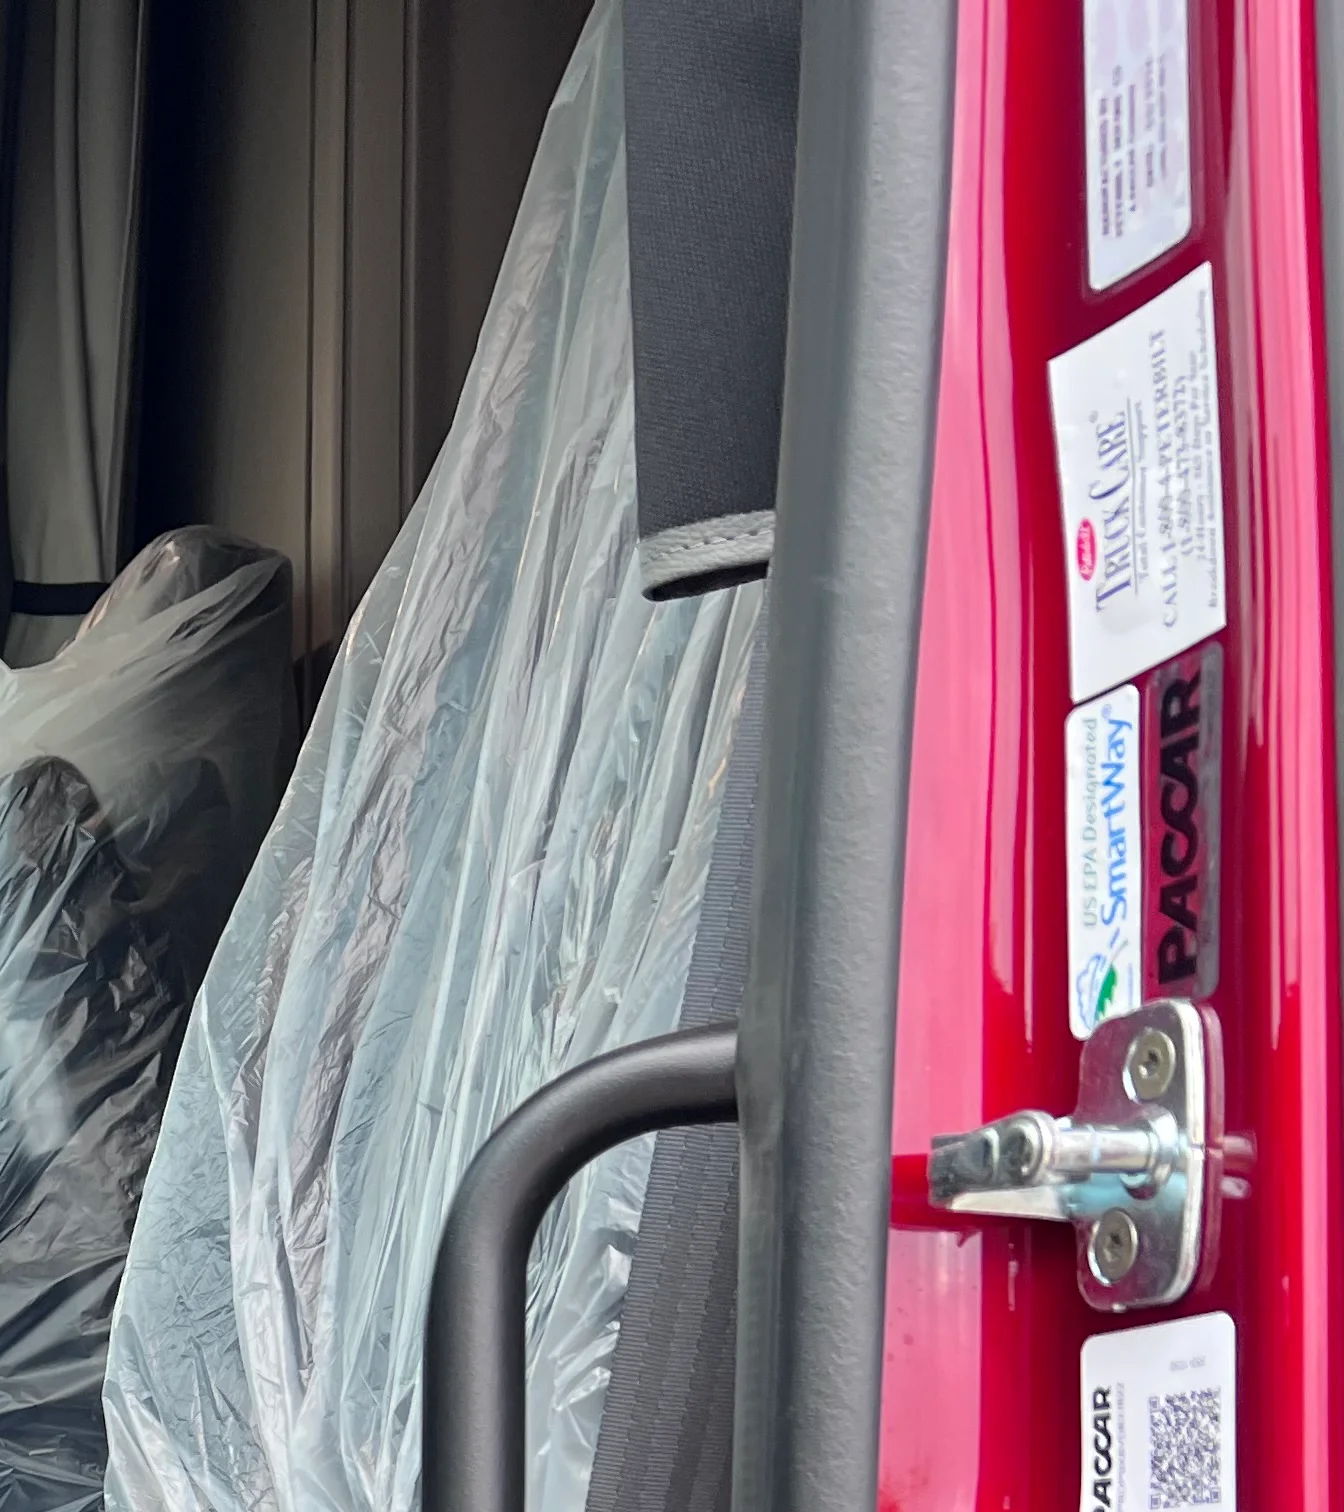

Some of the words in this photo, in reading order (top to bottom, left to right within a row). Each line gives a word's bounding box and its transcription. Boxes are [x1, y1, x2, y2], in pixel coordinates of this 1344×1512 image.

[1160, 556, 1179, 628] CALL
[1081, 716, 1100, 841] Designated
[1100, 717, 1133, 927] SmartWay
[1157, 669, 1201, 986] PACCAR
[1082, 846, 1098, 891] EPA
[1082, 896, 1098, 930] US
